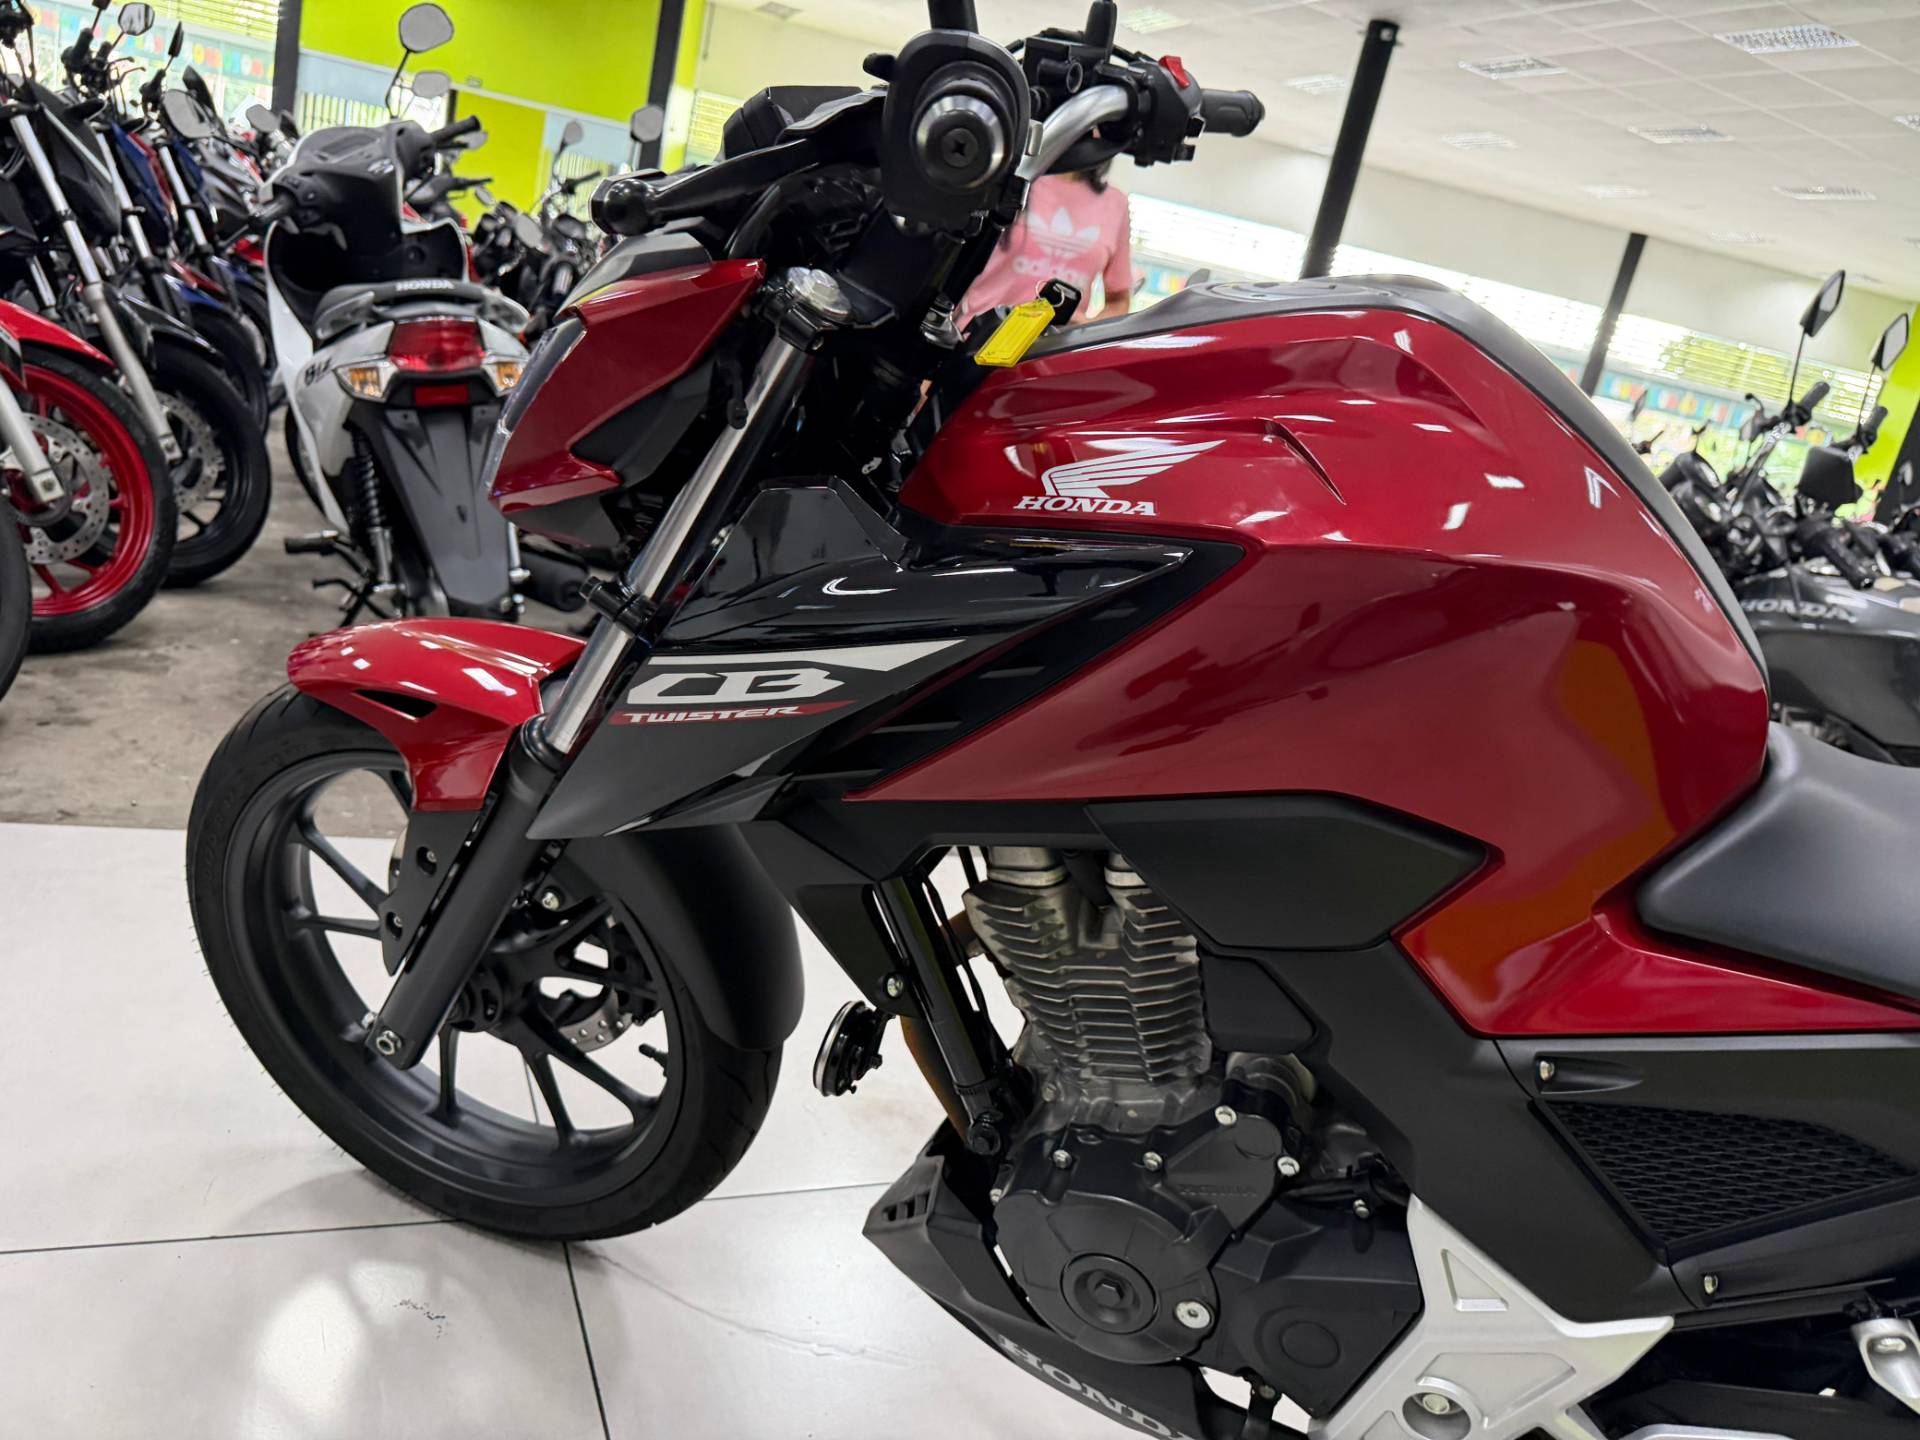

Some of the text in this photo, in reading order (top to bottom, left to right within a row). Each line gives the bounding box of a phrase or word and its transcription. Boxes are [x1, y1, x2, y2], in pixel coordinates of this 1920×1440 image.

[396, 280, 455, 291] HONDA
[1014, 496, 1156, 516] HONDA
[627, 668, 845, 704] CB
[623, 706, 801, 722] TWISTER
